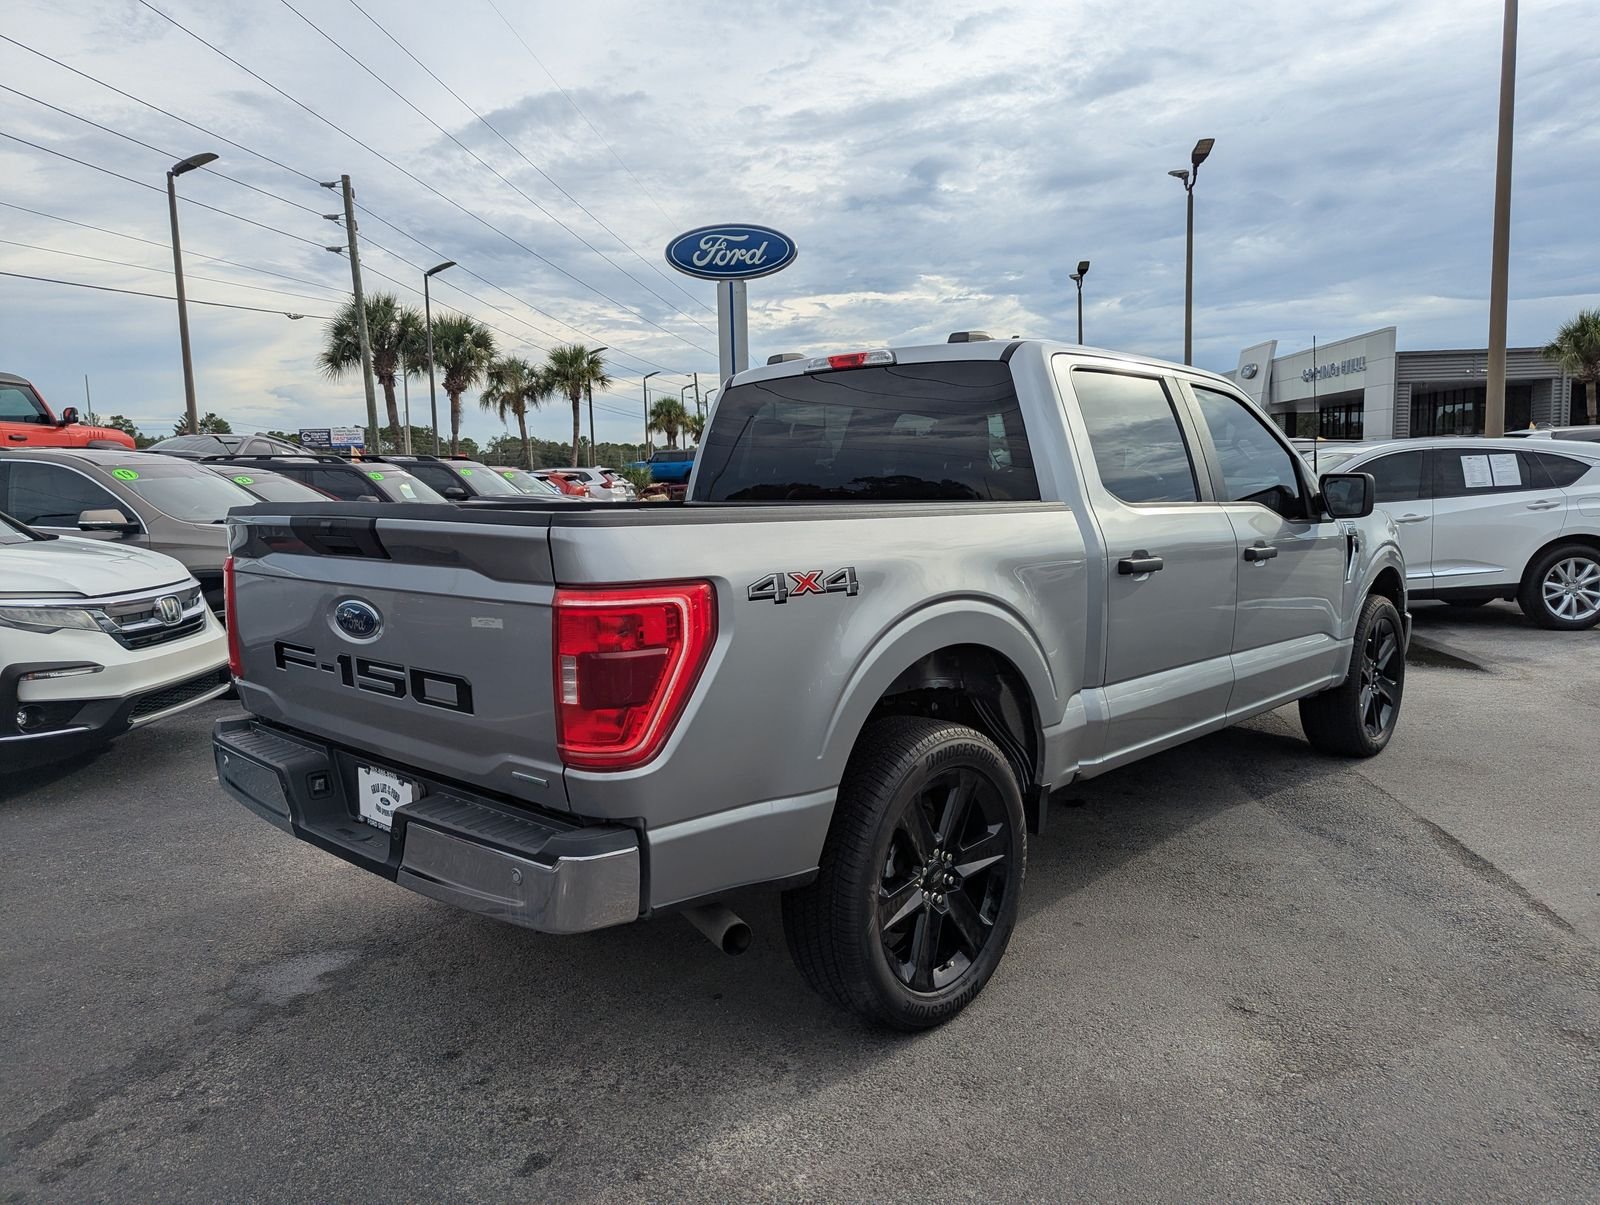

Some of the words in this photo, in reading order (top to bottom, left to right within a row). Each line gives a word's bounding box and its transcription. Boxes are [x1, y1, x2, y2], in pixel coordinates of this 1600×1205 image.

[692, 234, 769, 267] Ford
[1301, 362, 1340, 383] SPRING
[1341, 356, 1367, 375] HILL
[116, 470, 134, 479] 19
[337, 607, 367, 631] Ford
[273, 638, 475, 717] F-150
[925, 743, 1000, 772] BRIDGESTONE
[903, 979, 980, 1018] BRIDGESTONE
